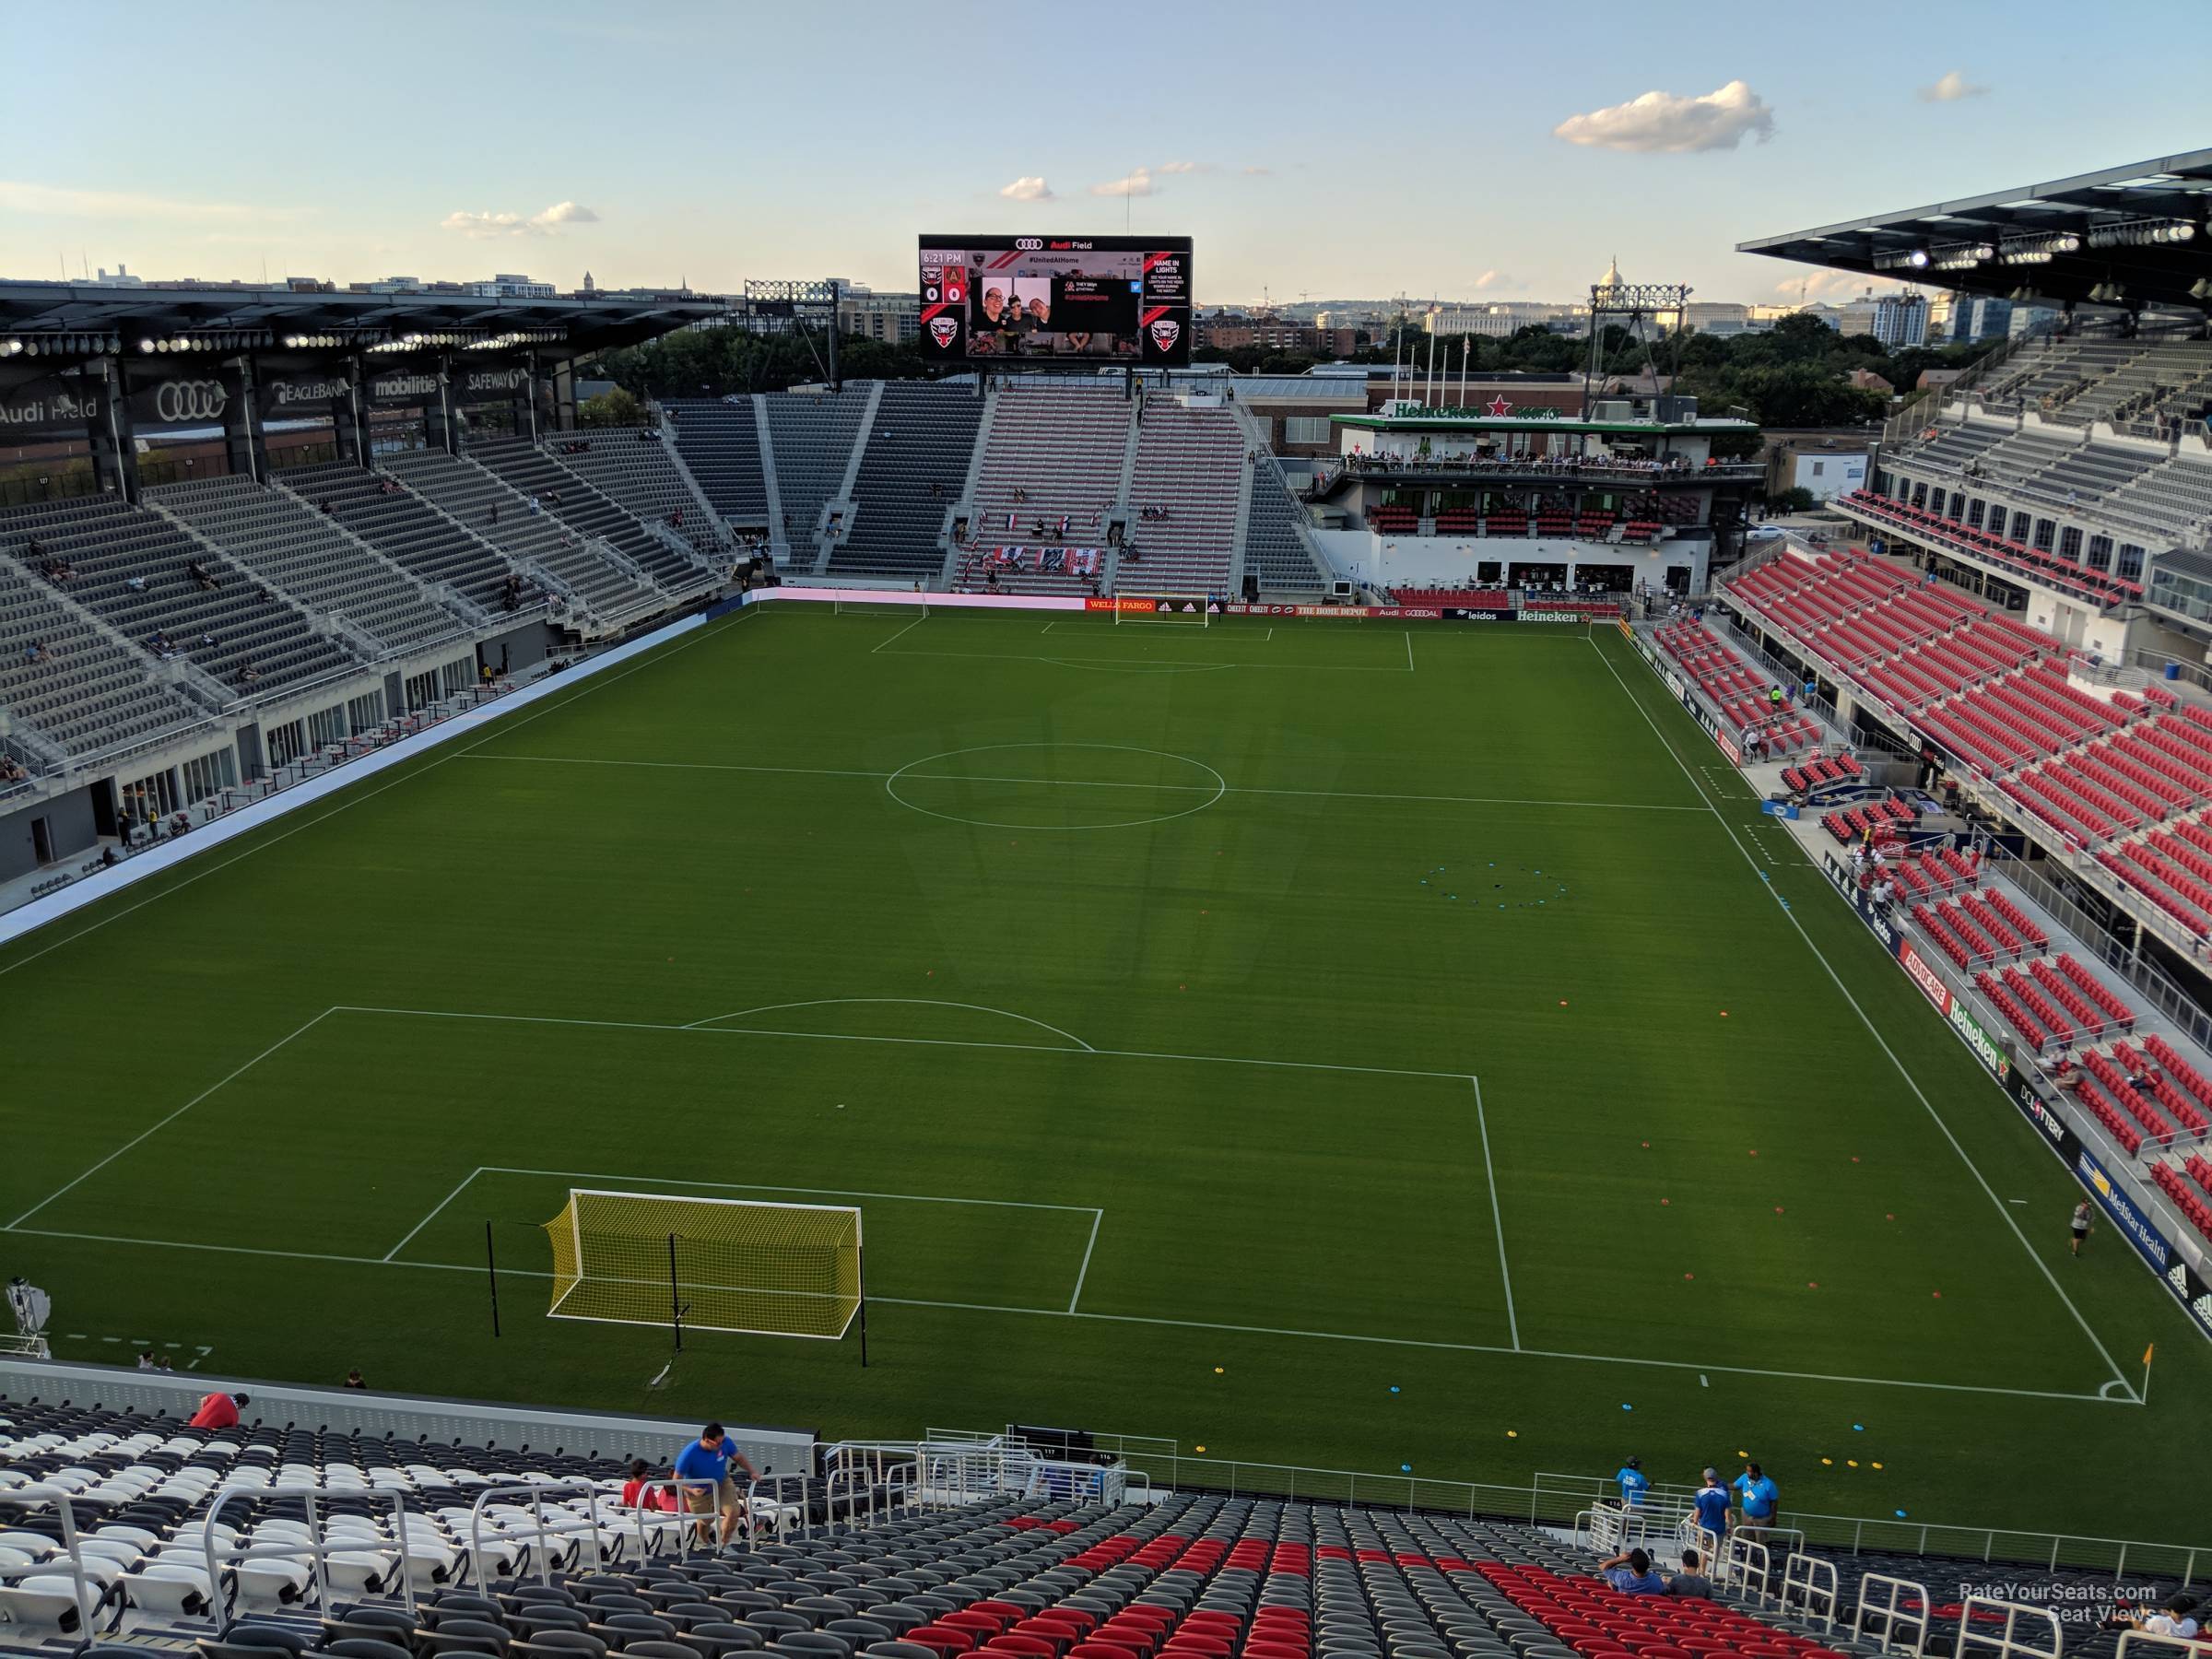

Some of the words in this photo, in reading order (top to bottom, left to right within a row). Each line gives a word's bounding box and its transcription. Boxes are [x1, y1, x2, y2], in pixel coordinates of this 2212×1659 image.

[1072, 241, 1092, 250] Field
[924, 253, 944, 263] 6:21
[947, 253, 961, 263] PM
[926, 287, 938, 301] 0
[948, 287, 960, 301] 0
[375, 375, 437, 396] mobilitie
[468, 372, 508, 390] SAFEWAY
[1394, 402, 1481, 418] Heineken
[1297, 606, 1313, 615] THE
[1316, 606, 1339, 616] HOME
[1340, 607, 1368, 617] DEPOT
[1379, 608, 1399, 617] Audi
[1468, 611, 1497, 620] leidos
[1517, 610, 1578, 623] Heineken
[1873, 912, 1891, 945] leidos
[1906, 951, 1945, 1004] ADVOCARE
[1949, 996, 1997, 1071] Heineken
[2109, 1189, 2139, 1232] MedStar
[2139, 1226, 2166, 1265] Health
